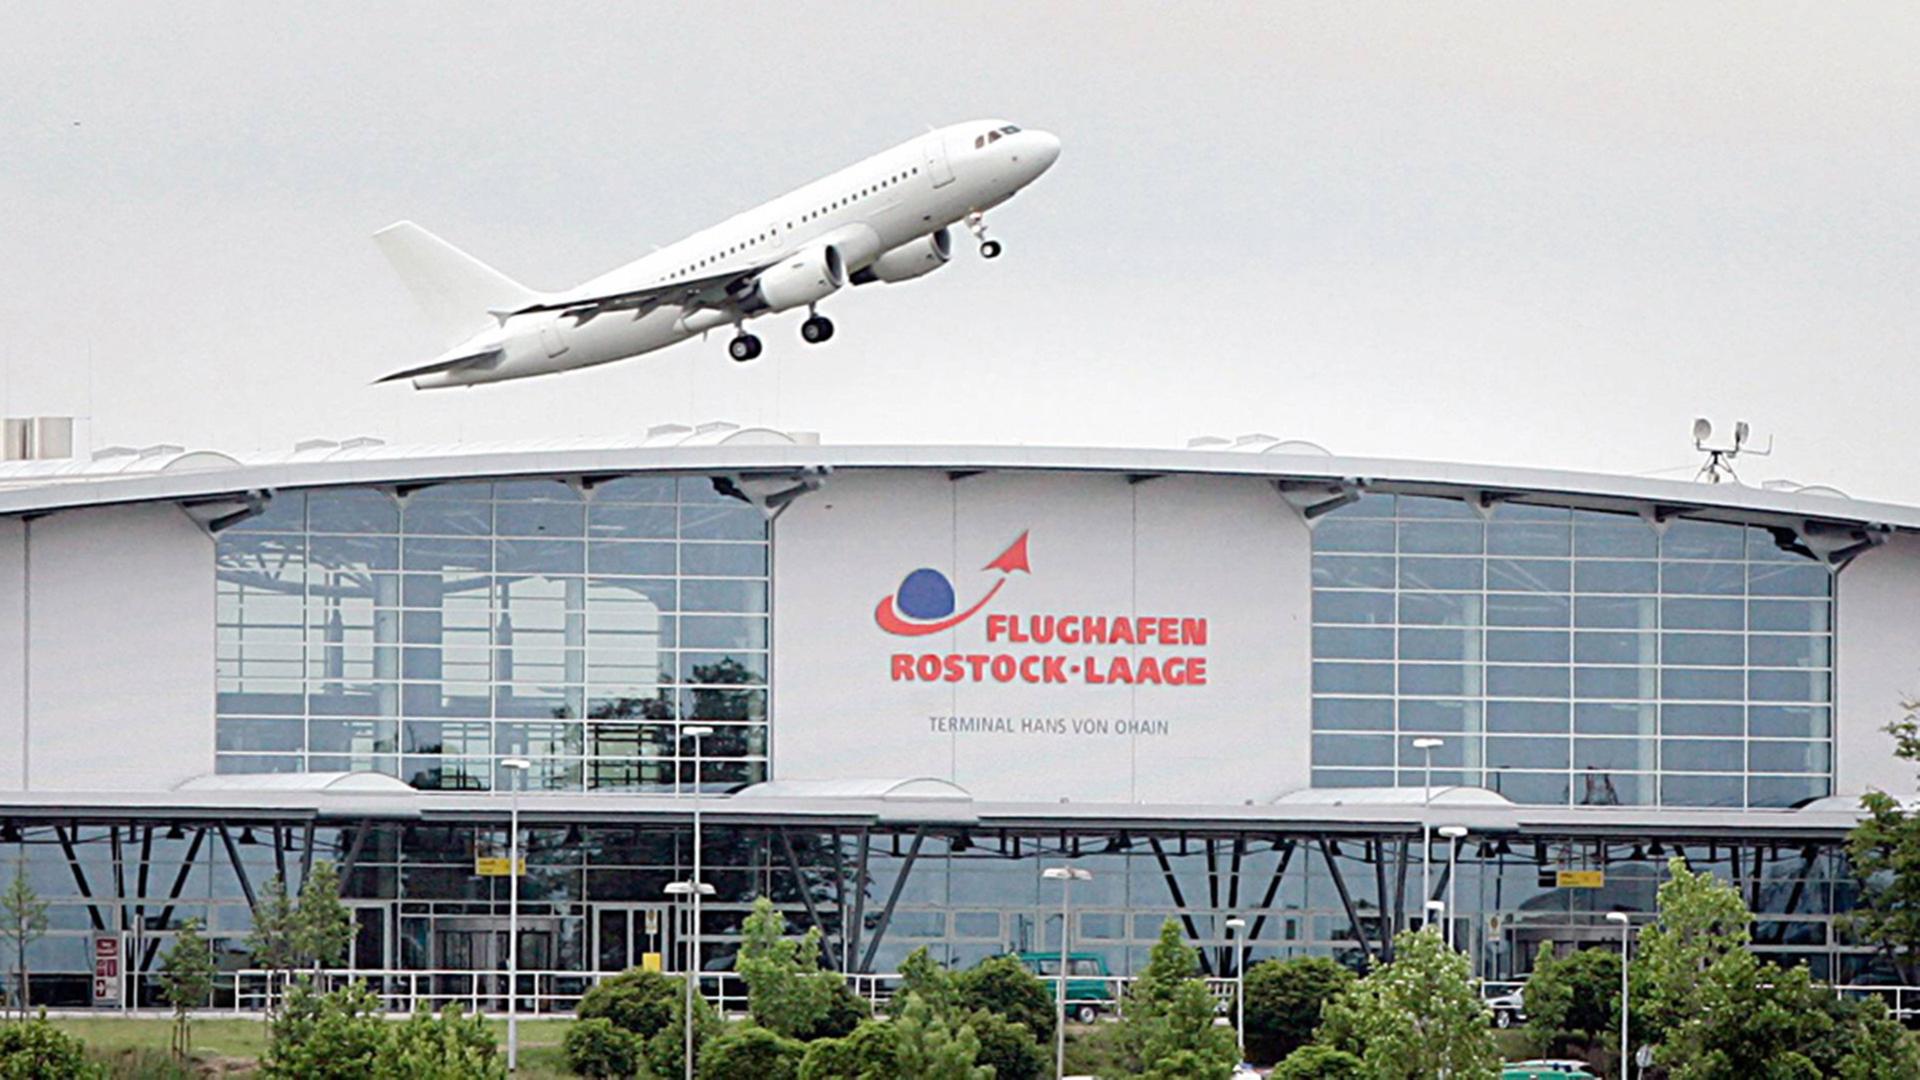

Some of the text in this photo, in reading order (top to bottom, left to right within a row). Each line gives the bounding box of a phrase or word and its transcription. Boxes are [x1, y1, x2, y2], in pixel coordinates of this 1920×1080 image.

[986, 614, 1207, 646] FLUGHAFEN
[930, 716, 1169, 736] TERMINAL HANS VON OHAIN
